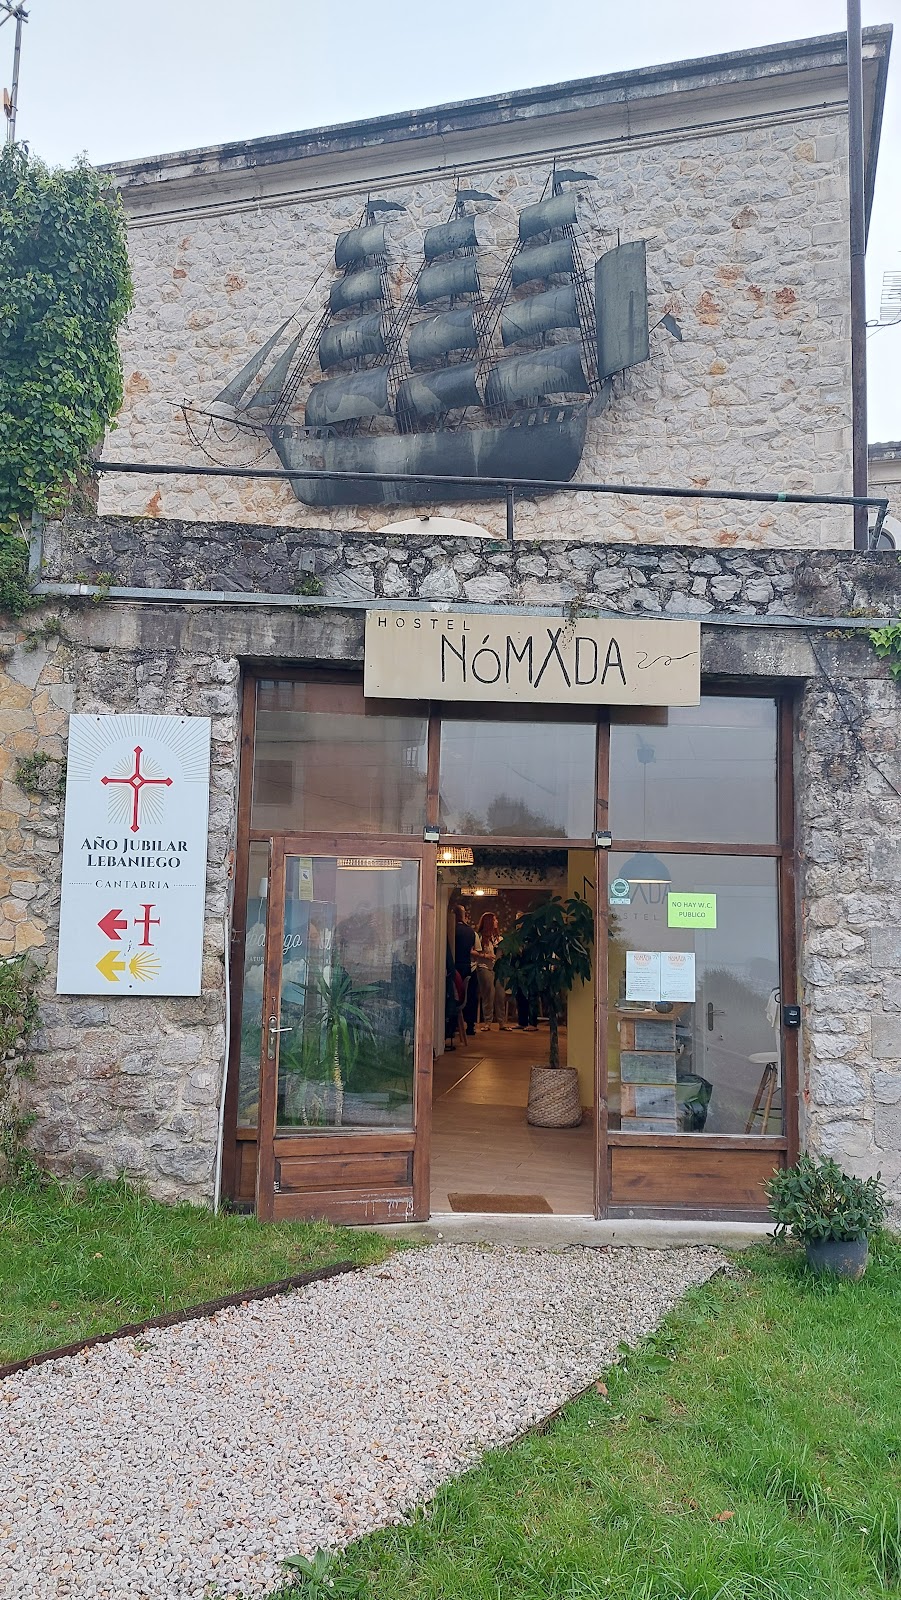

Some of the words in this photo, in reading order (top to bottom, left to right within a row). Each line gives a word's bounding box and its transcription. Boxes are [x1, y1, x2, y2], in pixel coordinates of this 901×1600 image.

[377, 616, 471, 631] HOSTEL
[81, 835, 118, 850] AÑO
[122, 838, 188, 854] JUBILAR
[87, 854, 181, 868] LEBANIEGO
[95, 879, 170, 889] CANTABRIA
